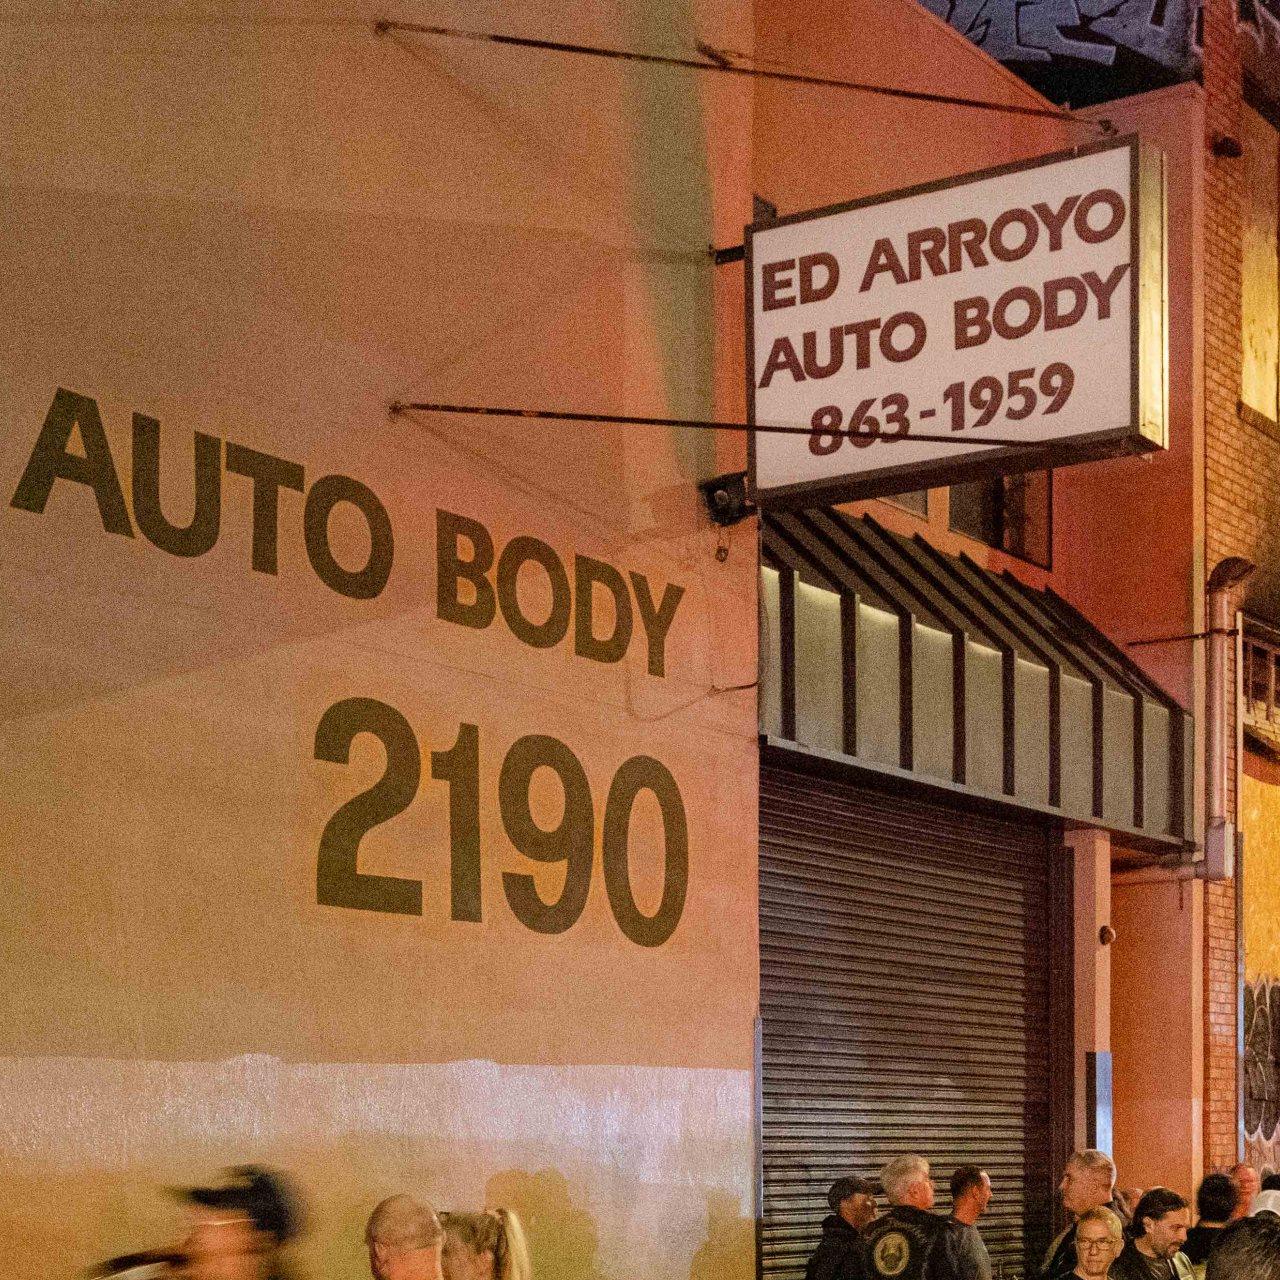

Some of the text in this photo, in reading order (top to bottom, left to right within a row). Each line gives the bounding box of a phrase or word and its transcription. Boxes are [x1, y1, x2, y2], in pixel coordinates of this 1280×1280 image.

[762, 188, 1126, 312] ED ARROYO
[758, 263, 1130, 389] AUTO BODY
[808, 361, 1075, 456] 863-1959
[11, 388, 394, 599] AUTO
[436, 508, 685, 678] BODY
[314, 697, 689, 948] 2190
